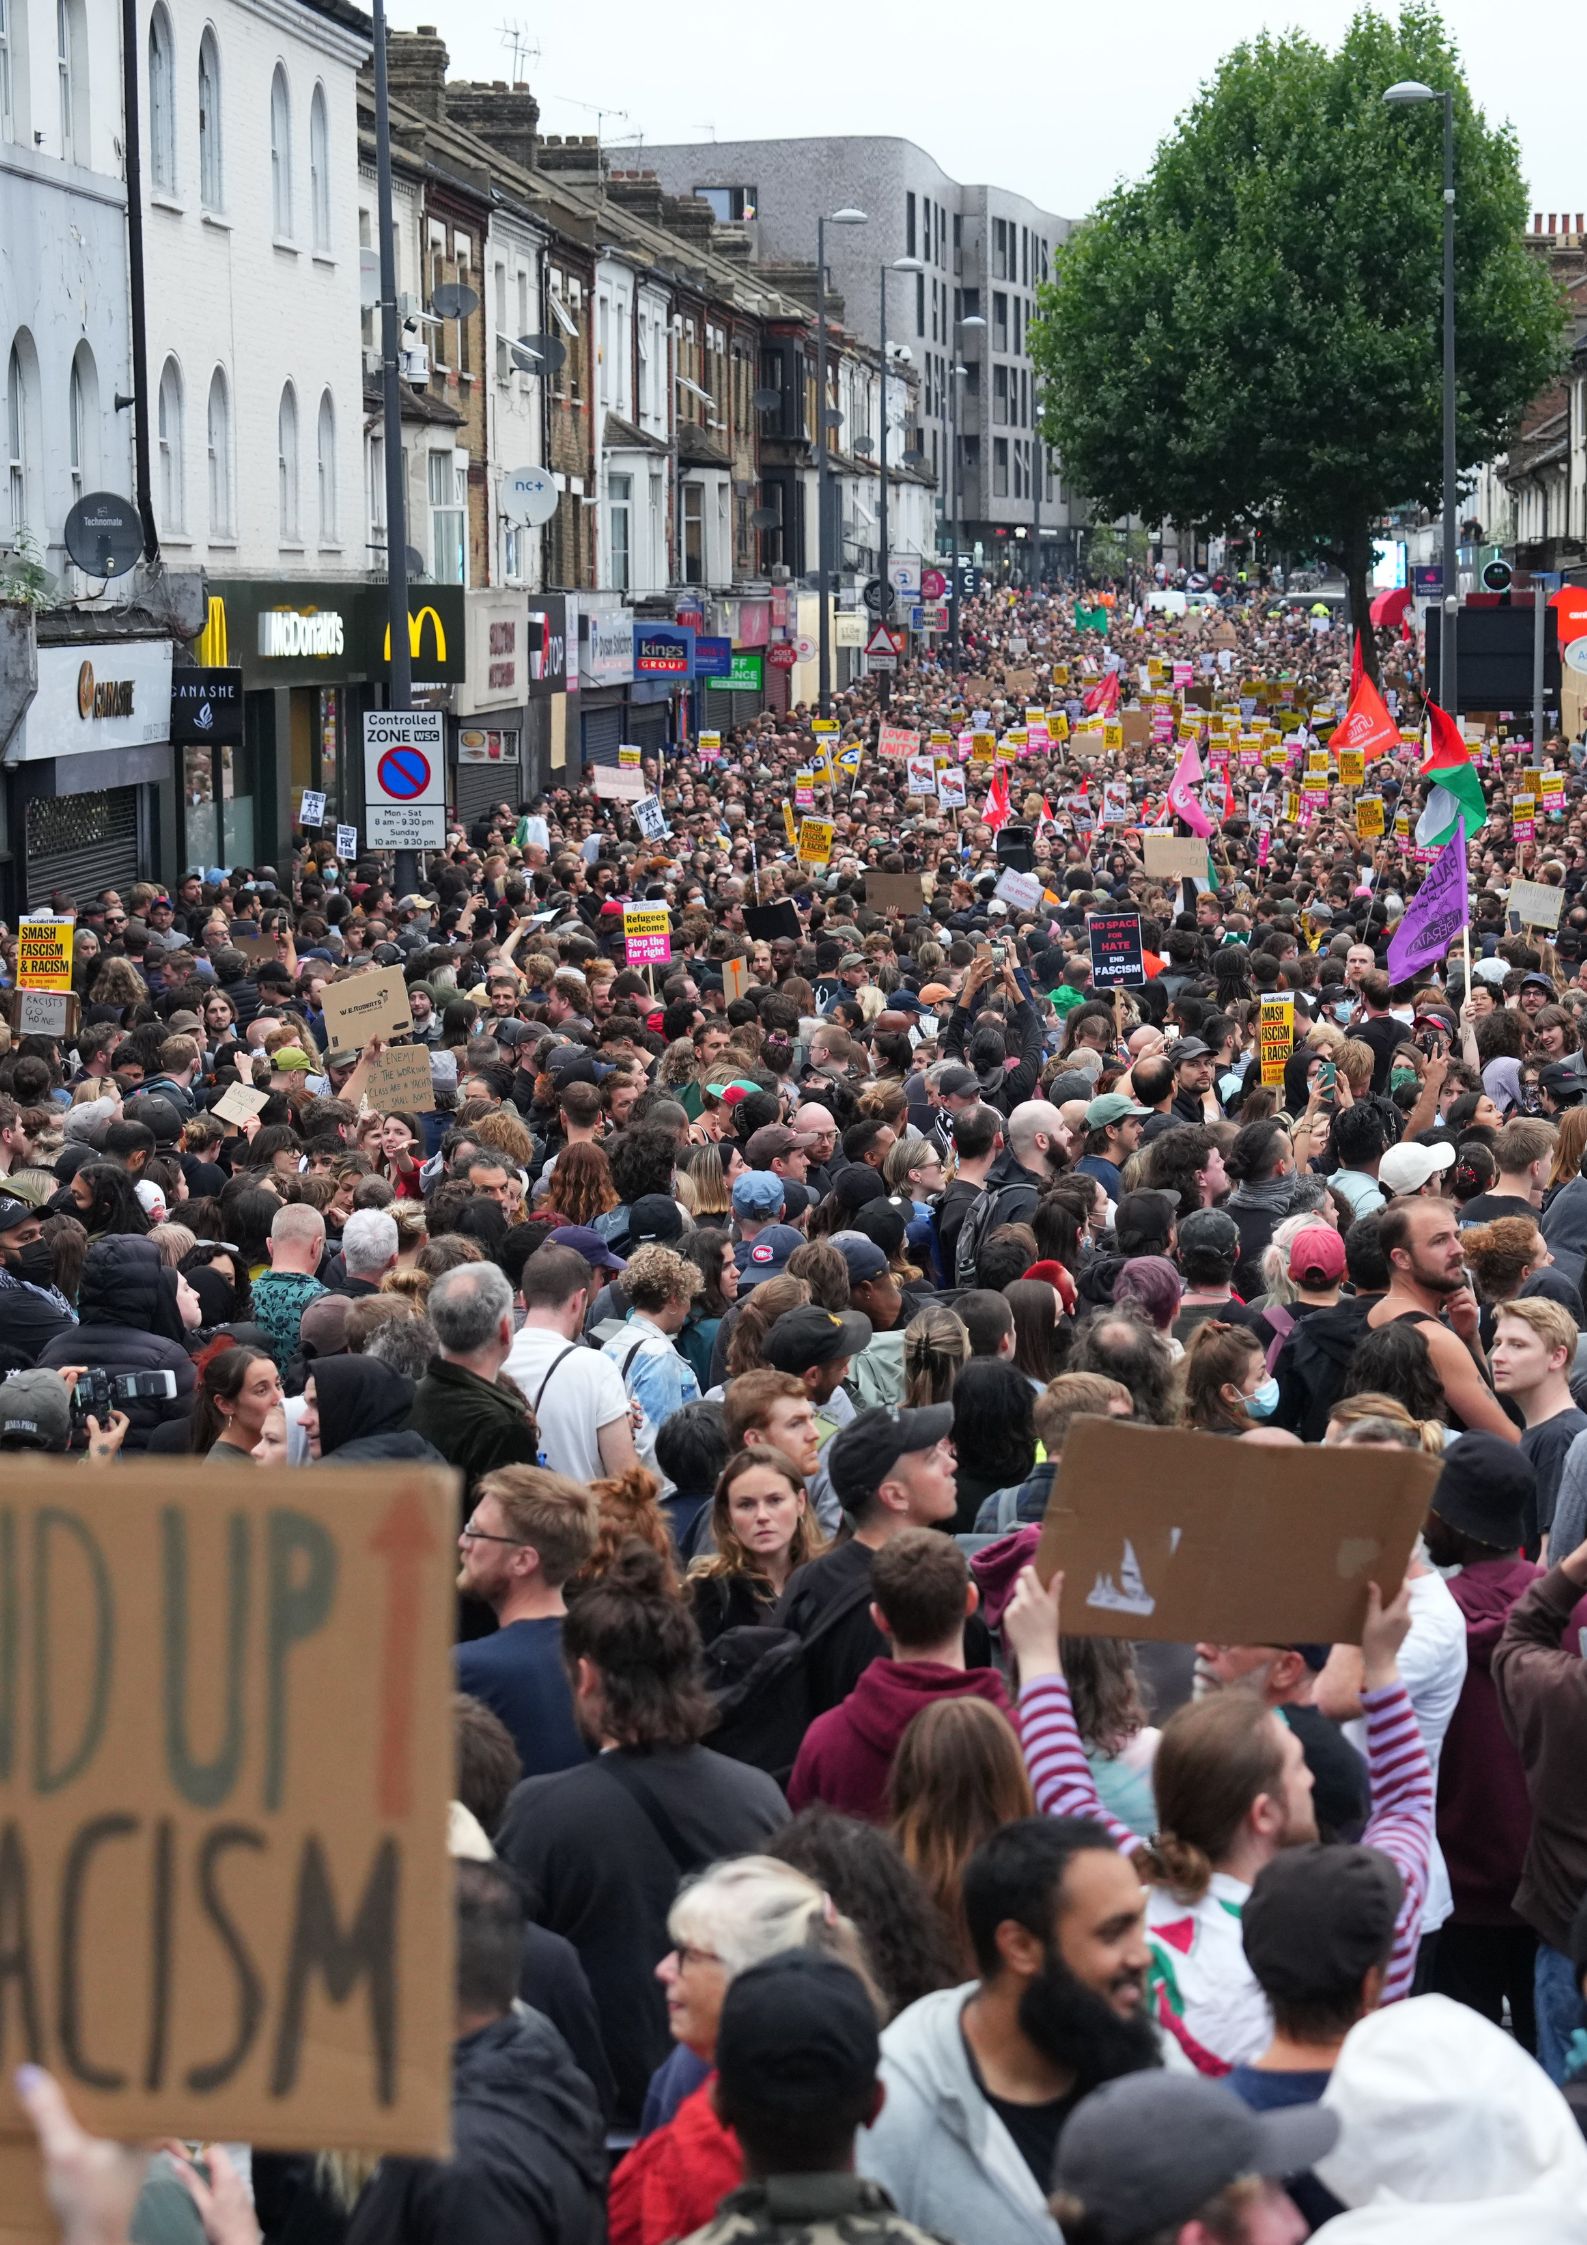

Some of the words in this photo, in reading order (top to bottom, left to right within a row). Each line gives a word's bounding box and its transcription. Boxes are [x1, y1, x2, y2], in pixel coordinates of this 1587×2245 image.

[84, 516, 122, 526] Technomate
[270, 612, 344, 657] McDonald's
[642, 640, 684, 659] kings
[642, 660, 683, 669] GROUP
[369, 714, 436, 725] Controlled
[367, 730, 411, 742] ZONE
[414, 731, 440, 741] WSC
[882, 728, 912, 741] LOVE
[879, 742, 918, 756] UNITY
[390, 829, 419, 837] Sunday
[803, 822, 823, 832] SMASH
[802, 832, 826, 841] FASCISM
[806, 842, 828, 851] RACISM
[626, 913, 665, 923] Refugees
[627, 924, 664, 933] welcome
[1091, 922, 1104, 930] NO
[1106, 920, 1137, 929] SPACE
[22, 927, 56, 940] SMASH
[628, 938, 648, 948] Stop
[649, 936, 665, 945] the
[1101, 941, 1130, 951] HATE
[21, 944, 63, 956] FASCISM
[628, 949, 641, 958] far
[643, 947, 665, 958] right
[20, 960, 27, 972] &
[32, 961, 68, 972] RACISM
[1095, 964, 1141, 976] FASCISM
[27, 996, 63, 1007] RACISTS
[26, 1006, 43, 1016] GO
[1262, 1006, 1283, 1021] SMASH
[29, 1016, 55, 1025] HOME
[1262, 1025, 1289, 1041] FASCISM
[386, 1050, 414, 1064] ENEMY
[1262, 1046, 1266, 1062] &
[368, 1074, 377, 1083] OF
[381, 1069, 394, 1082] THE
[398, 1066, 426, 1076] WORKING
[369, 1088, 388, 1097] CLASS
[412, 1092, 432, 1104] BOATS
[0, 1505, 118, 1798] D
[157, 1500, 340, 1815] UP
